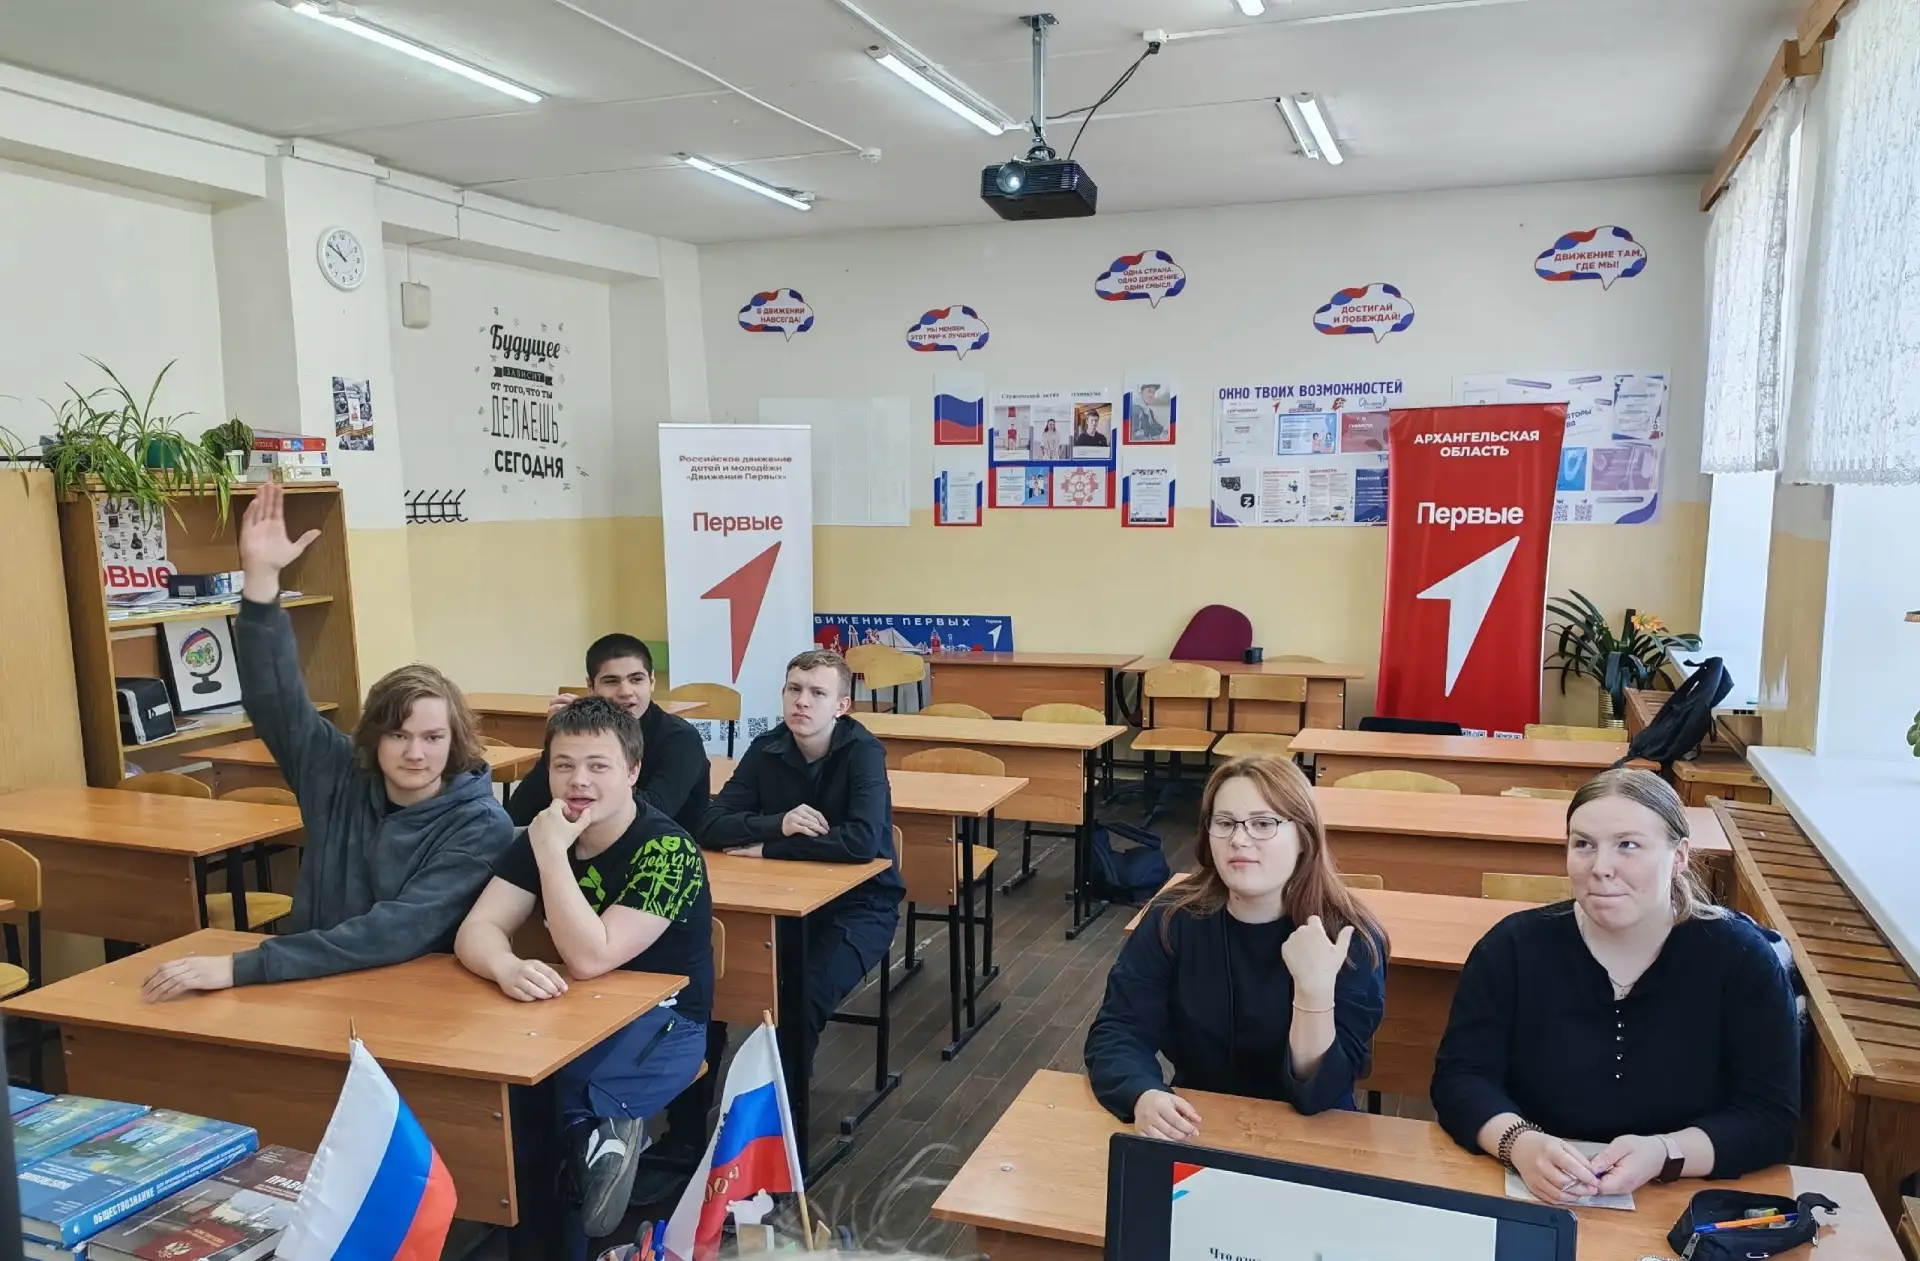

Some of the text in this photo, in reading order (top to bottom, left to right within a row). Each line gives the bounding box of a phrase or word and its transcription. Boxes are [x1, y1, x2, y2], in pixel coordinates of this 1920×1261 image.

[1554, 251, 1615, 262] ДВИЖЕНИЕ
[1576, 261, 1620, 271] ГДЕ МЫ!
[1342, 303, 1393, 314] ДОСТИГАЙ
[1342, 312, 1401, 323] ПОБЕЖДАЙ!
[490, 324, 561, 363] Будущее
[1218, 379, 1403, 400] ОКНО ТВОИХ ВОЗМОЖНОСТЕЙ
[490, 395, 559, 444] ДЕЛАЕШЬ
[1414, 430, 1540, 444] АРХАНГЕЛЬСКАЯ
[678, 455, 740, 463] Российское
[1440, 446, 1510, 458] ОБЛАСТЬ
[494, 449, 564, 479] СЕГОДНЯ
[690, 464, 721, 472] детей
[731, 464, 782, 472] молодёжи
[1417, 502, 1524, 531] Первые
[692, 512, 784, 537] Первые
[103, 564, 172, 588] вые
[814, 616, 971, 627] ВИЖЕНИЕ ПЕРВЫХ
[93, 1188, 155, 1226] ОБЩЕСТВОЗНАНИЕ
[1208, 1246, 1232, 1261] Что
